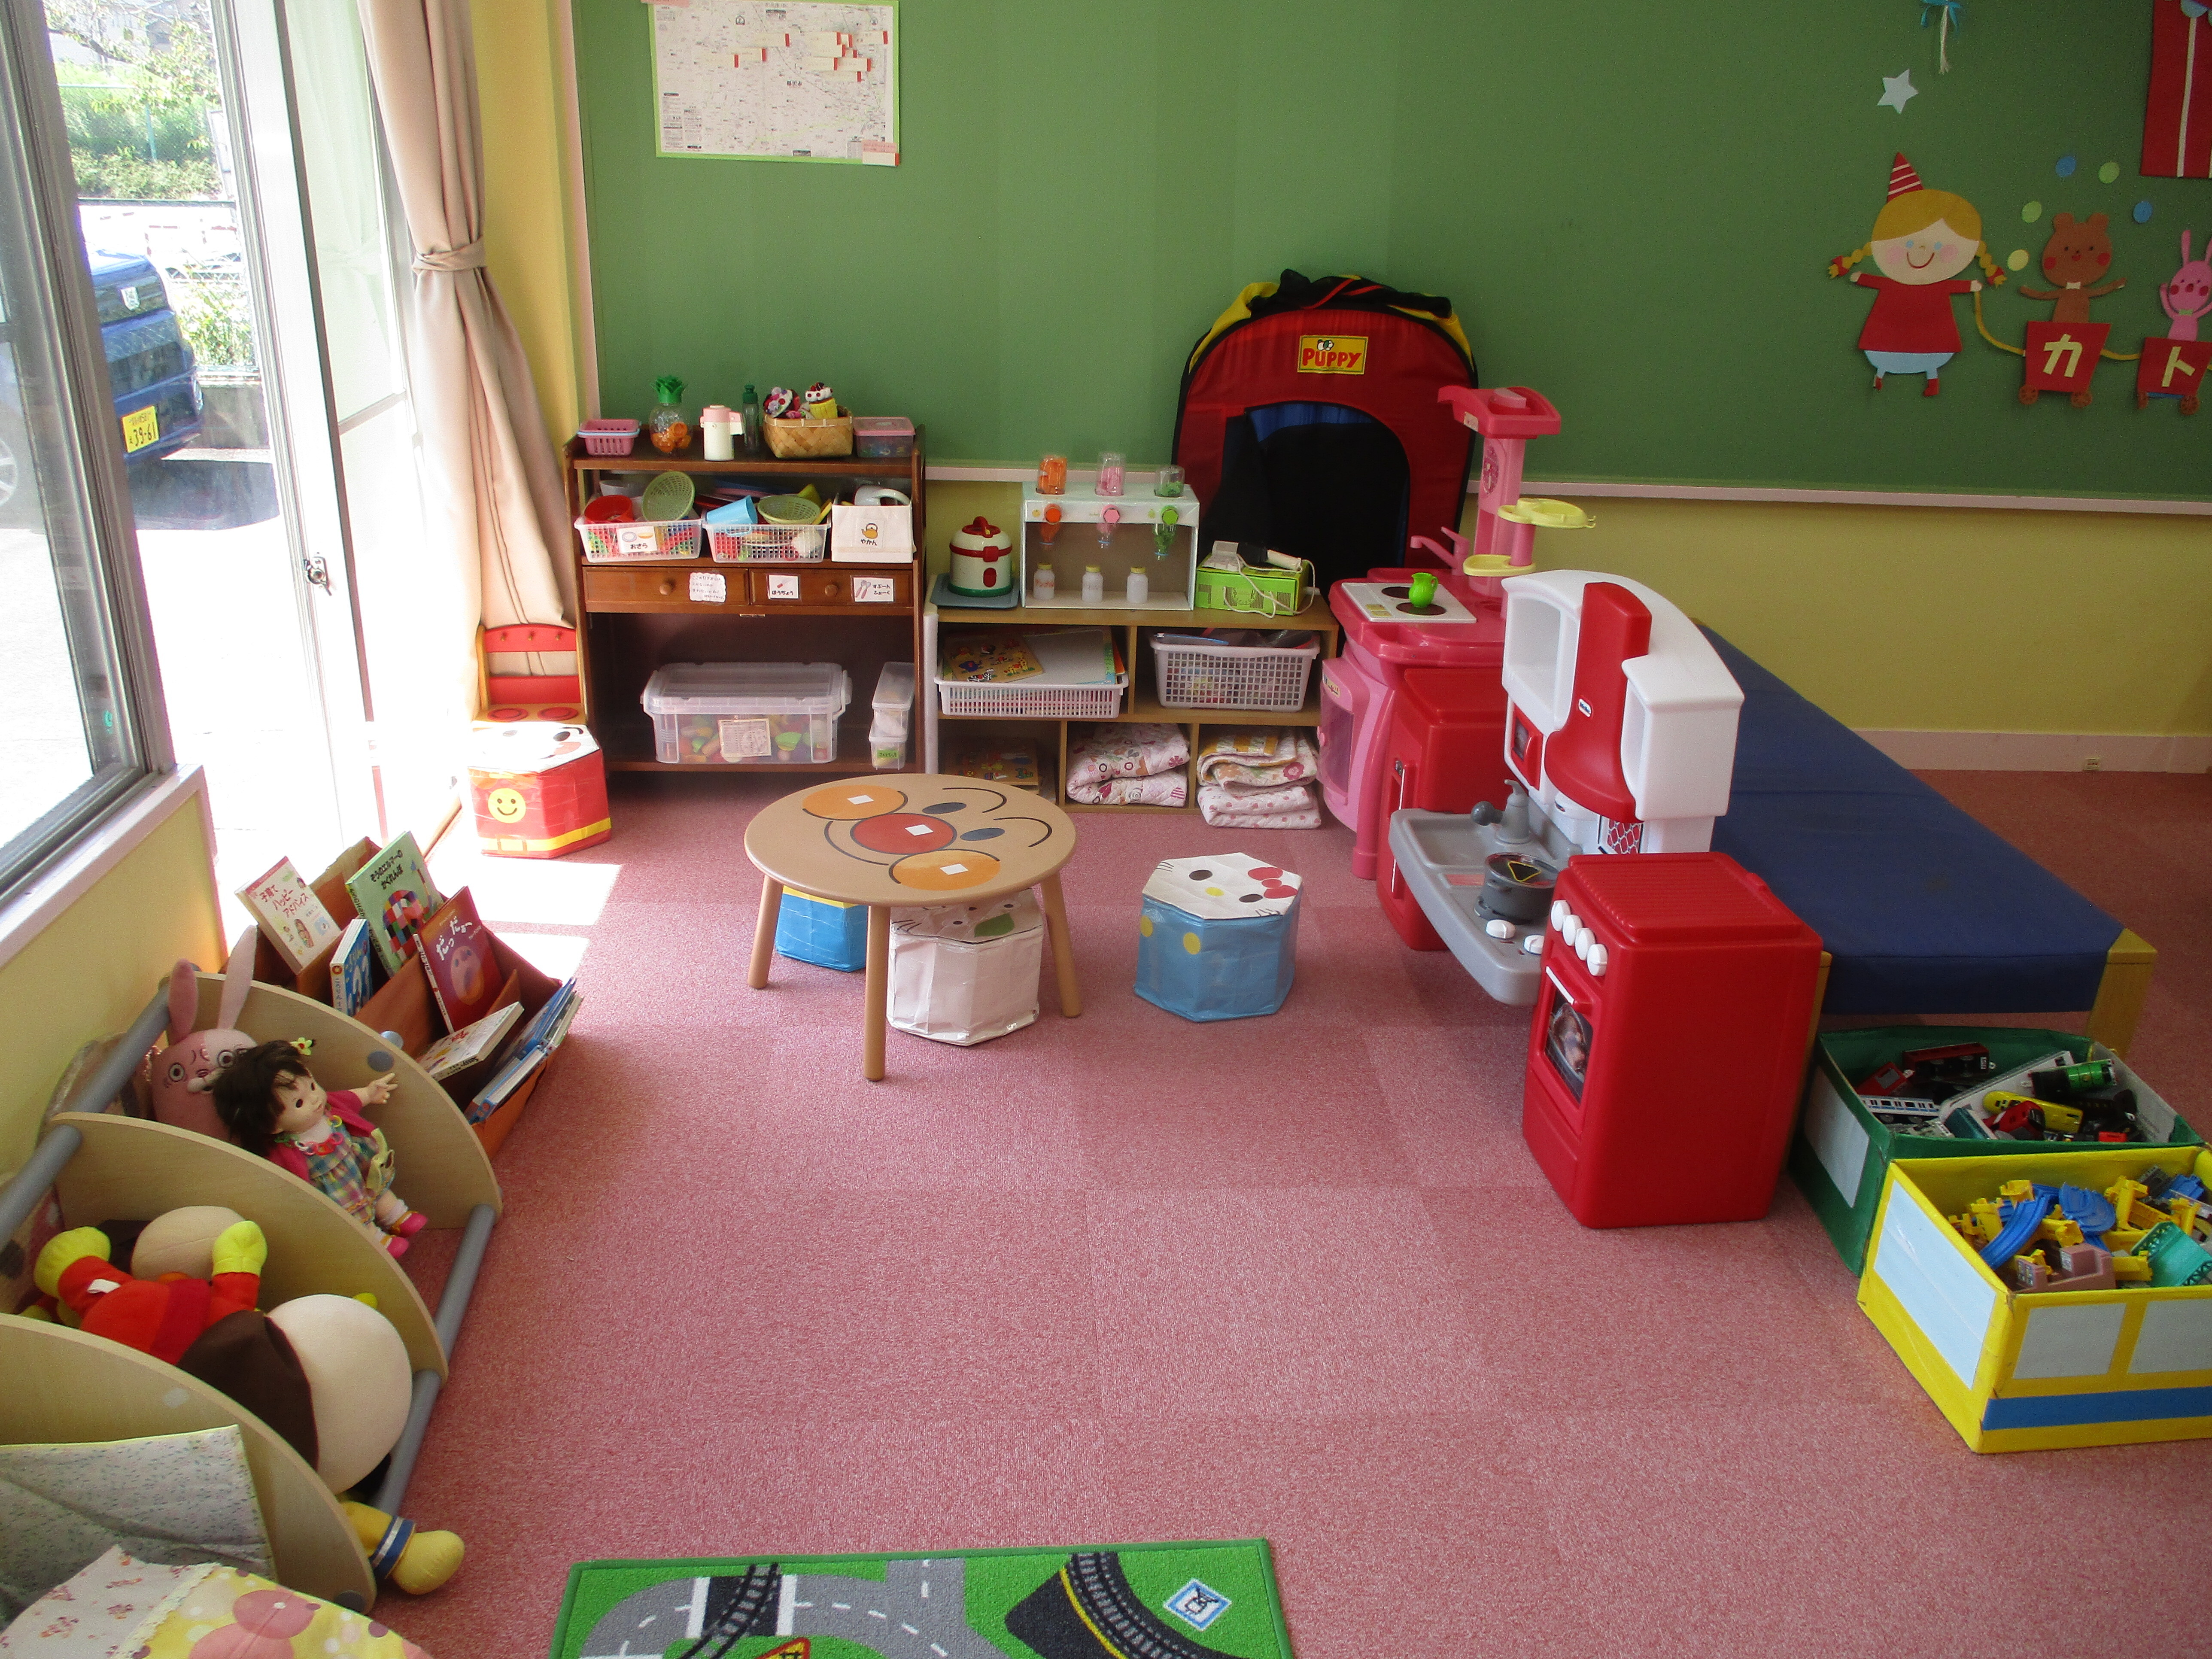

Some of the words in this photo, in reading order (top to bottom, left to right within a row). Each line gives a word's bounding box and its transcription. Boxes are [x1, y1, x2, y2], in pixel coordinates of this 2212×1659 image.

[1302, 348, 1362, 368] PUPPY
[2042, 333, 2083, 378] カ
[2161, 346, 2196, 387] ト
[134, 422, 156, 447] 39-61
[259, 884, 279, 902] 子育て
[272, 889, 294, 911] ハッピー
[283, 893, 310, 918] アドバイス
